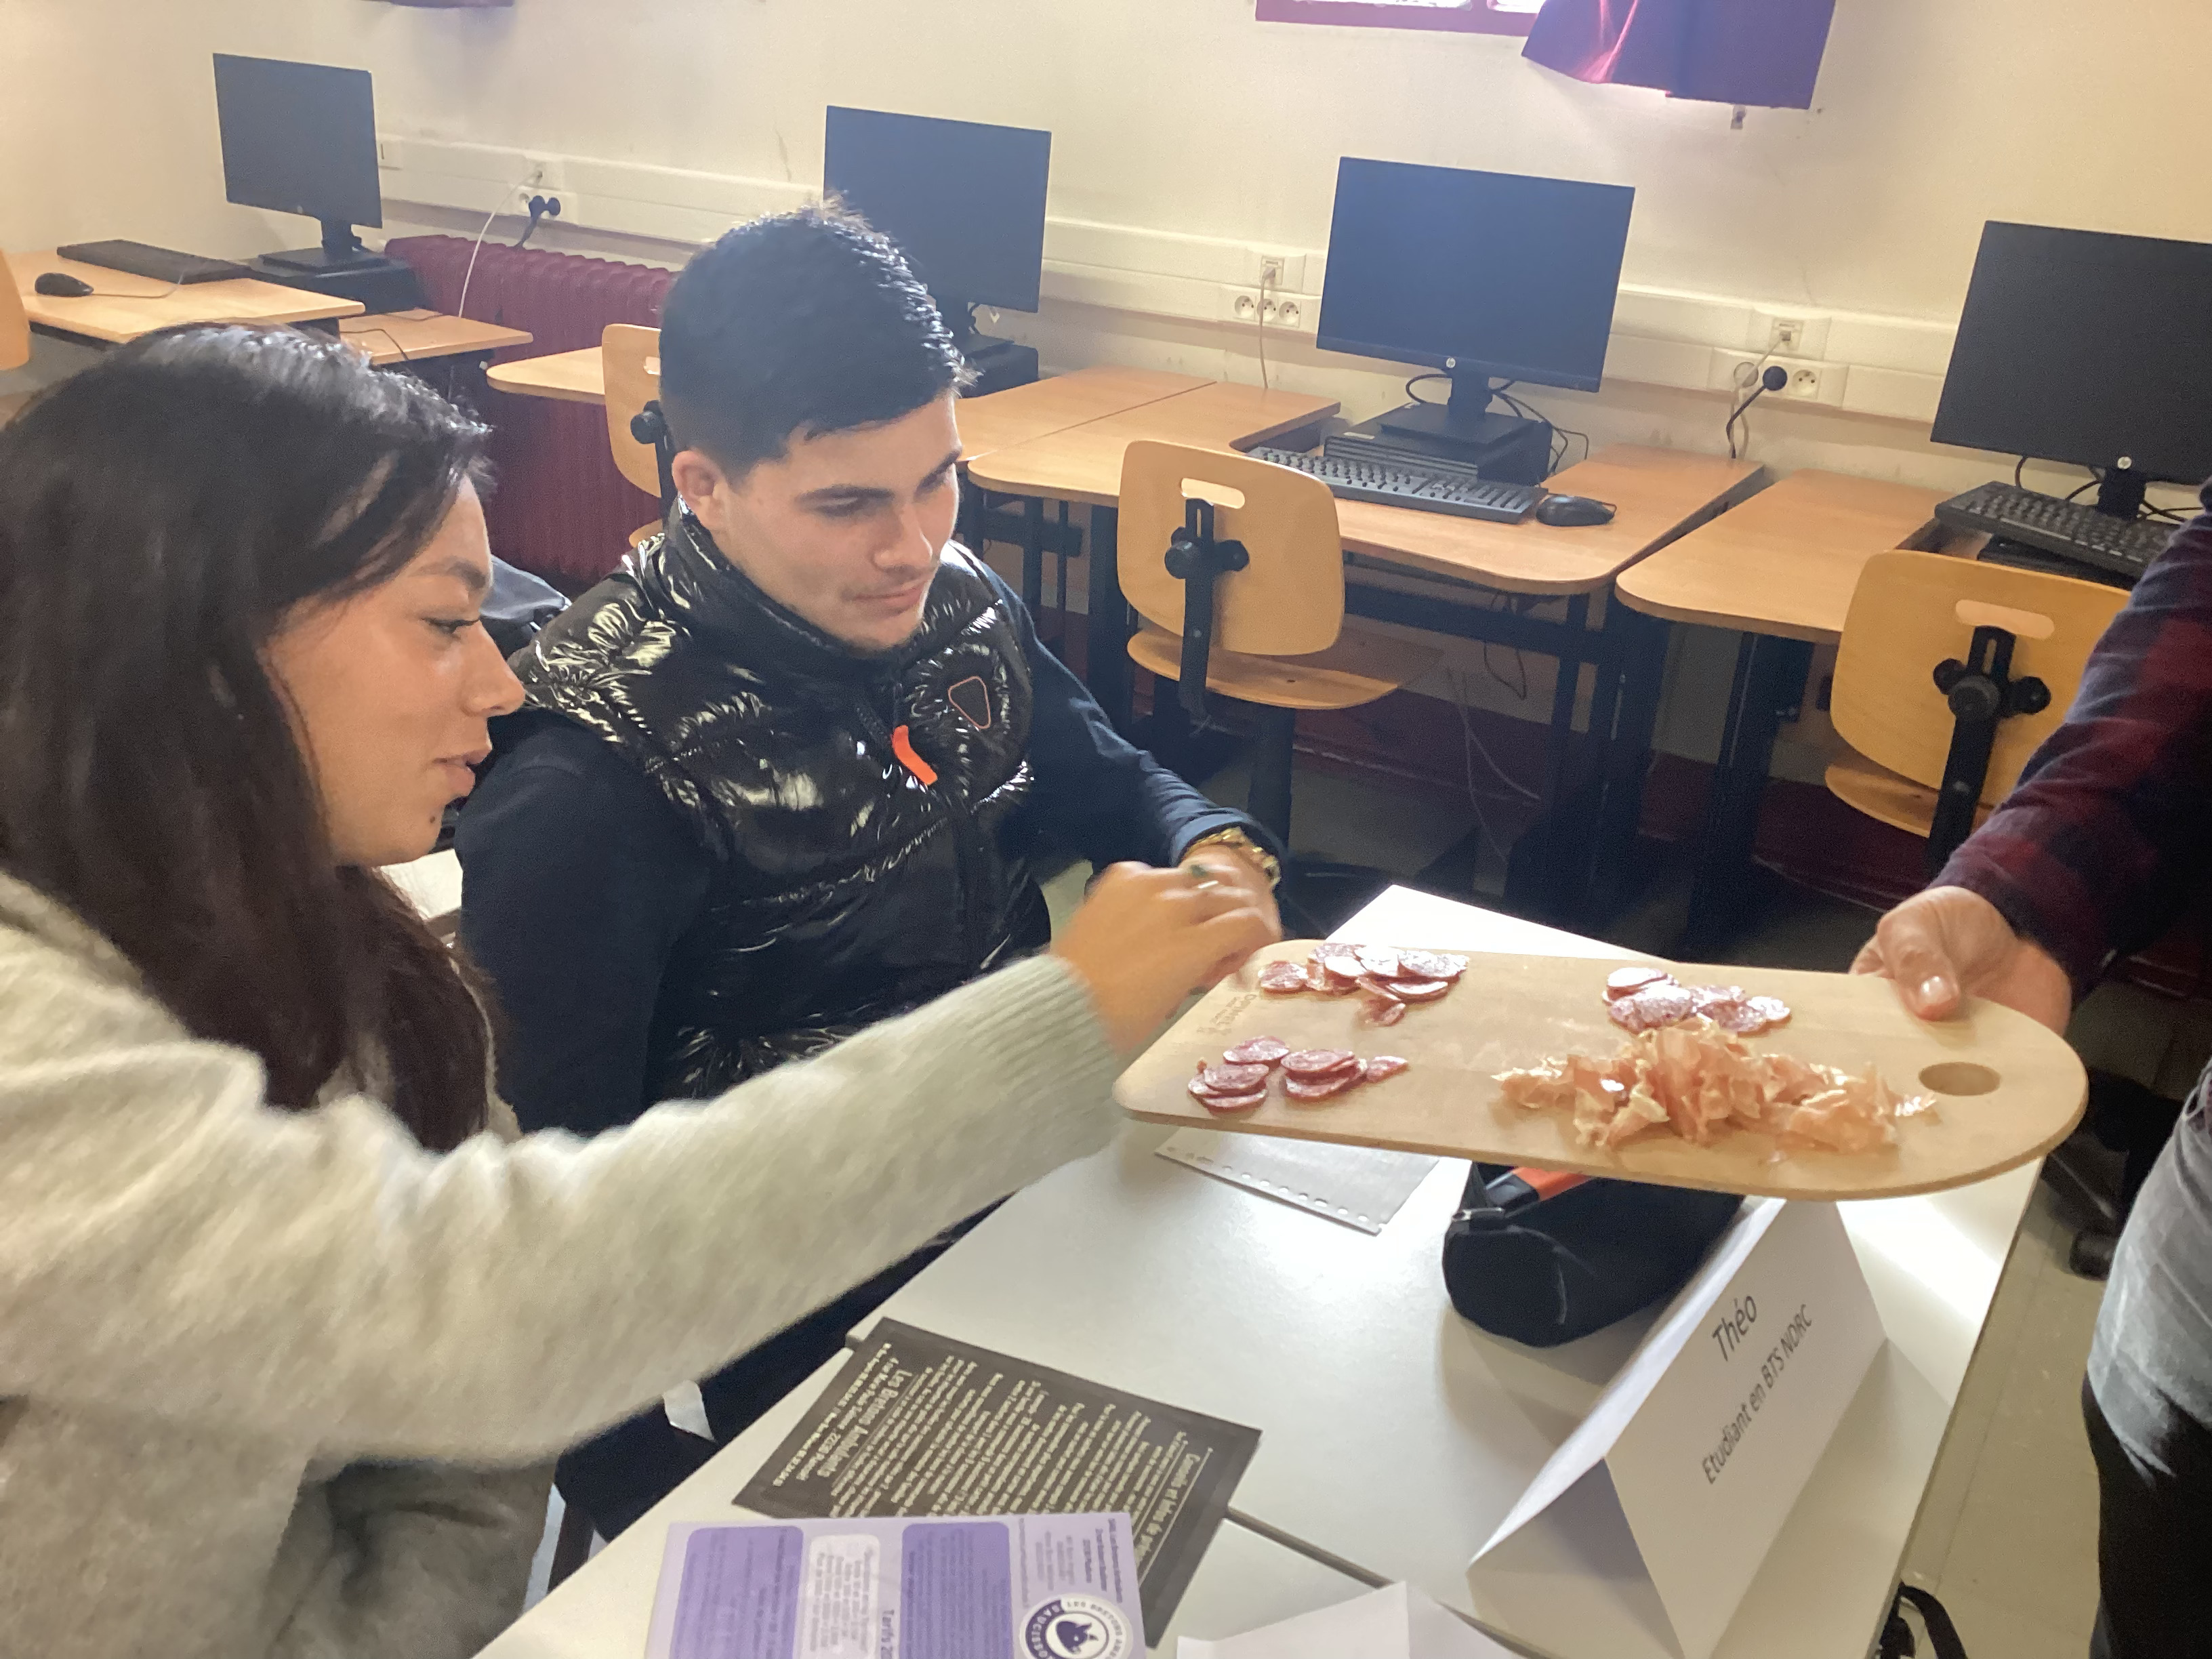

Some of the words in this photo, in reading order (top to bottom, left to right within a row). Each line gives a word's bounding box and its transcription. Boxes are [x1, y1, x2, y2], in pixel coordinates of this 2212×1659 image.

[1712, 1295, 1757, 1361] Théo
[1702, 1403, 1753, 1484] Etudiant
[1749, 1383, 1766, 1412] en
[1761, 1347, 1785, 1389] BTS
[1780, 1304, 1812, 1359] NDRC
